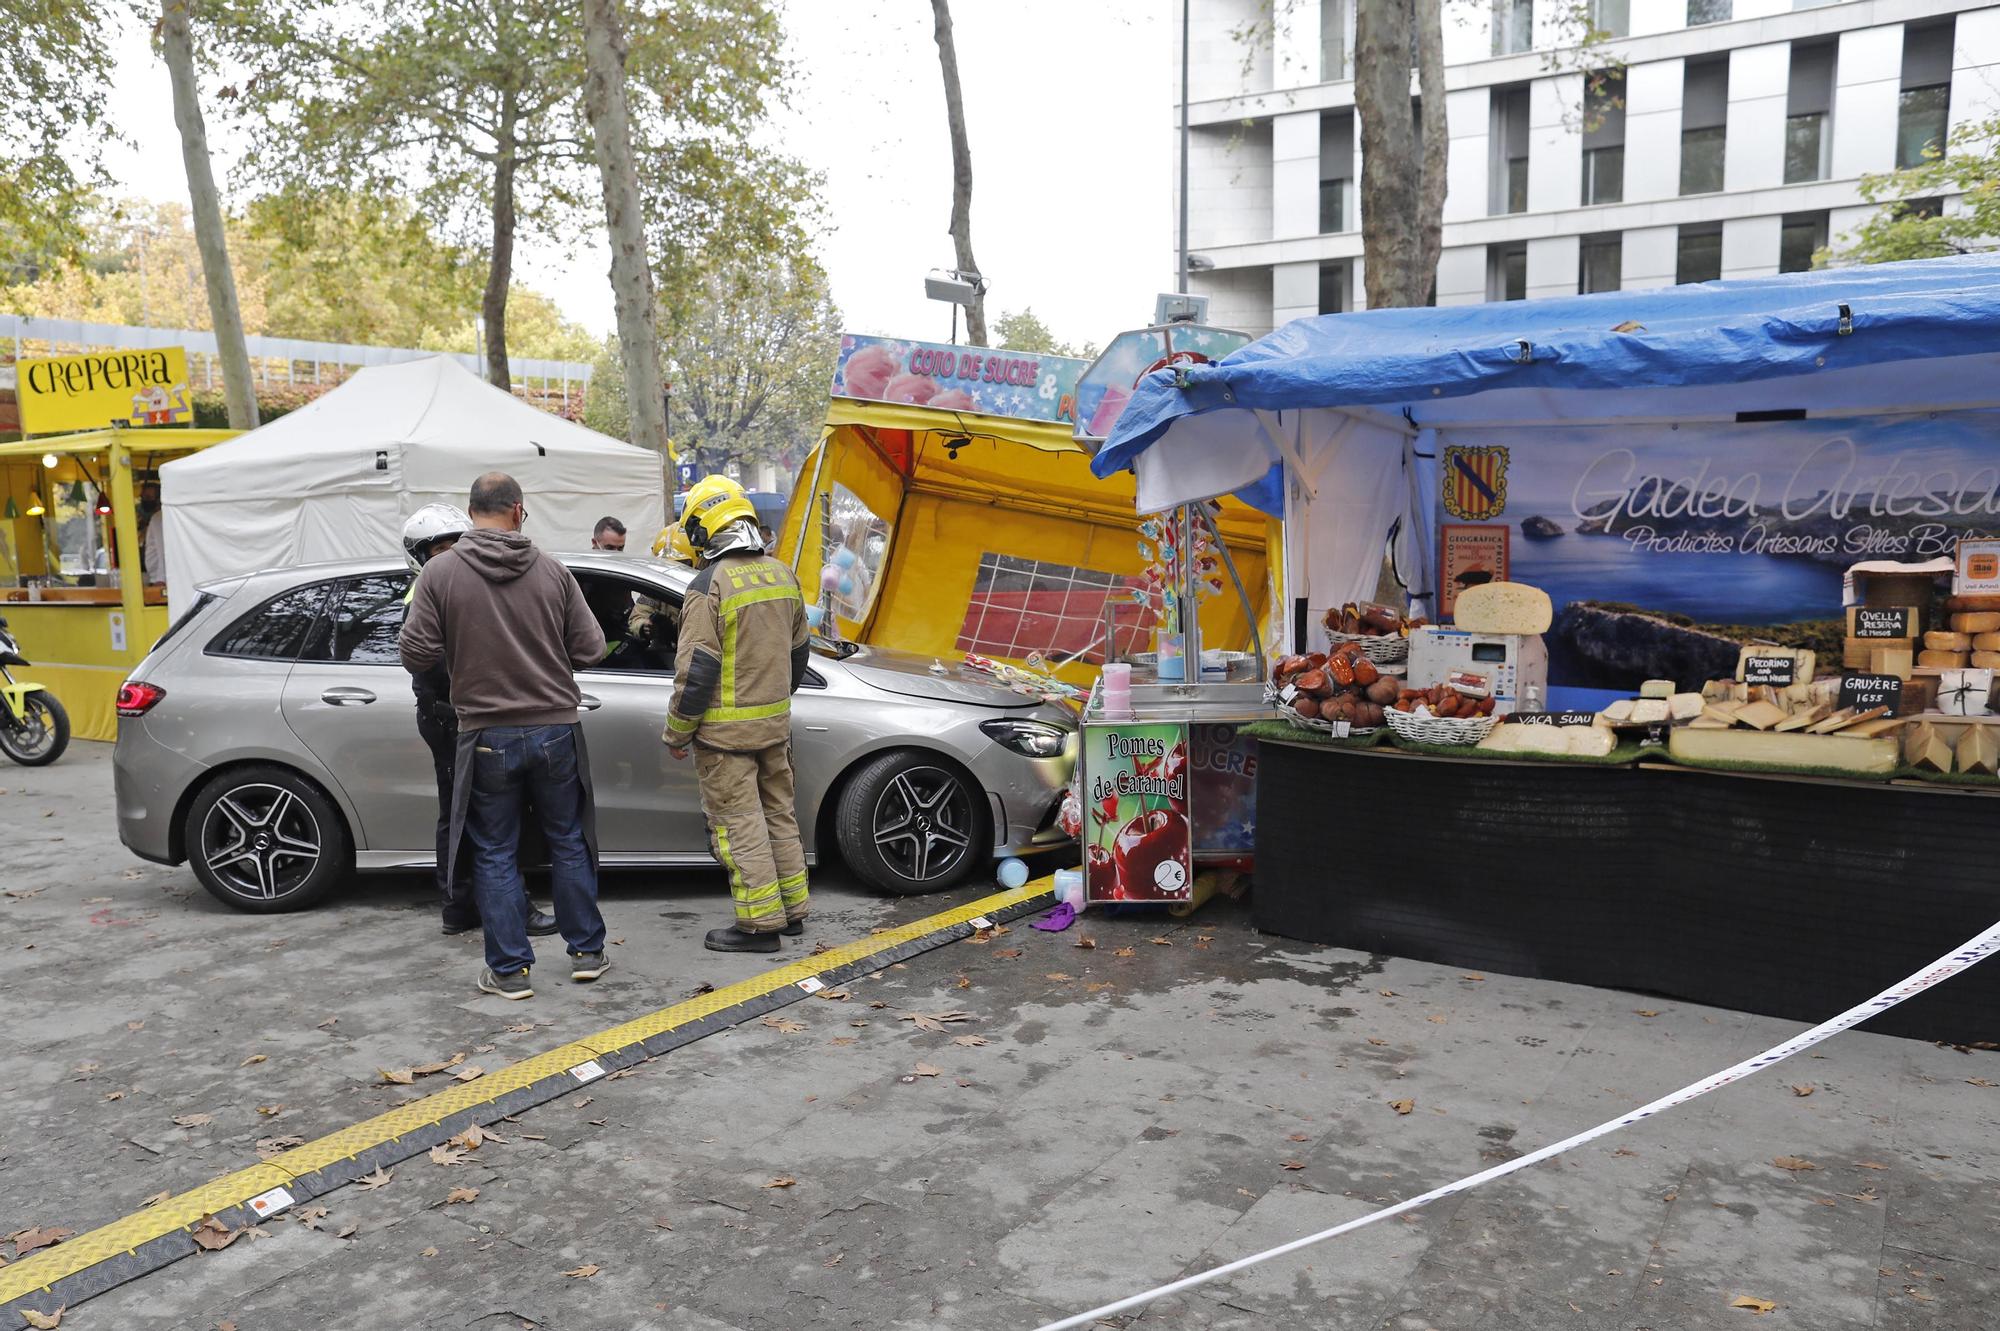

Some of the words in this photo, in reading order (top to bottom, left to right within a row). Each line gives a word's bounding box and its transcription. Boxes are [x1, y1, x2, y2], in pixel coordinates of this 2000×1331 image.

[910, 349, 955, 377] COTO
[958, 353, 982, 381] DE
[983, 356, 1039, 387] SUCRE
[1038, 374, 1058, 400] &
[1571, 448, 1759, 533] Gadea
[1623, 525, 1734, 554] Productes
[1738, 523, 1838, 555] Artesans
[1842, 524, 1910, 555] Illes
[1860, 610, 1902, 622] OVELLA
[1863, 621, 1902, 630] RESERVA
[1845, 676, 1900, 691] GRUYÈRE
[1856, 693, 1884, 703] 1655
[1518, 714, 1554, 725] VACA
[1559, 714, 1592, 725] SUAU
[1106, 733, 1165, 760] Pomes
[1093, 775, 1112, 801] de
[1116, 769, 1184, 800] Caramel
